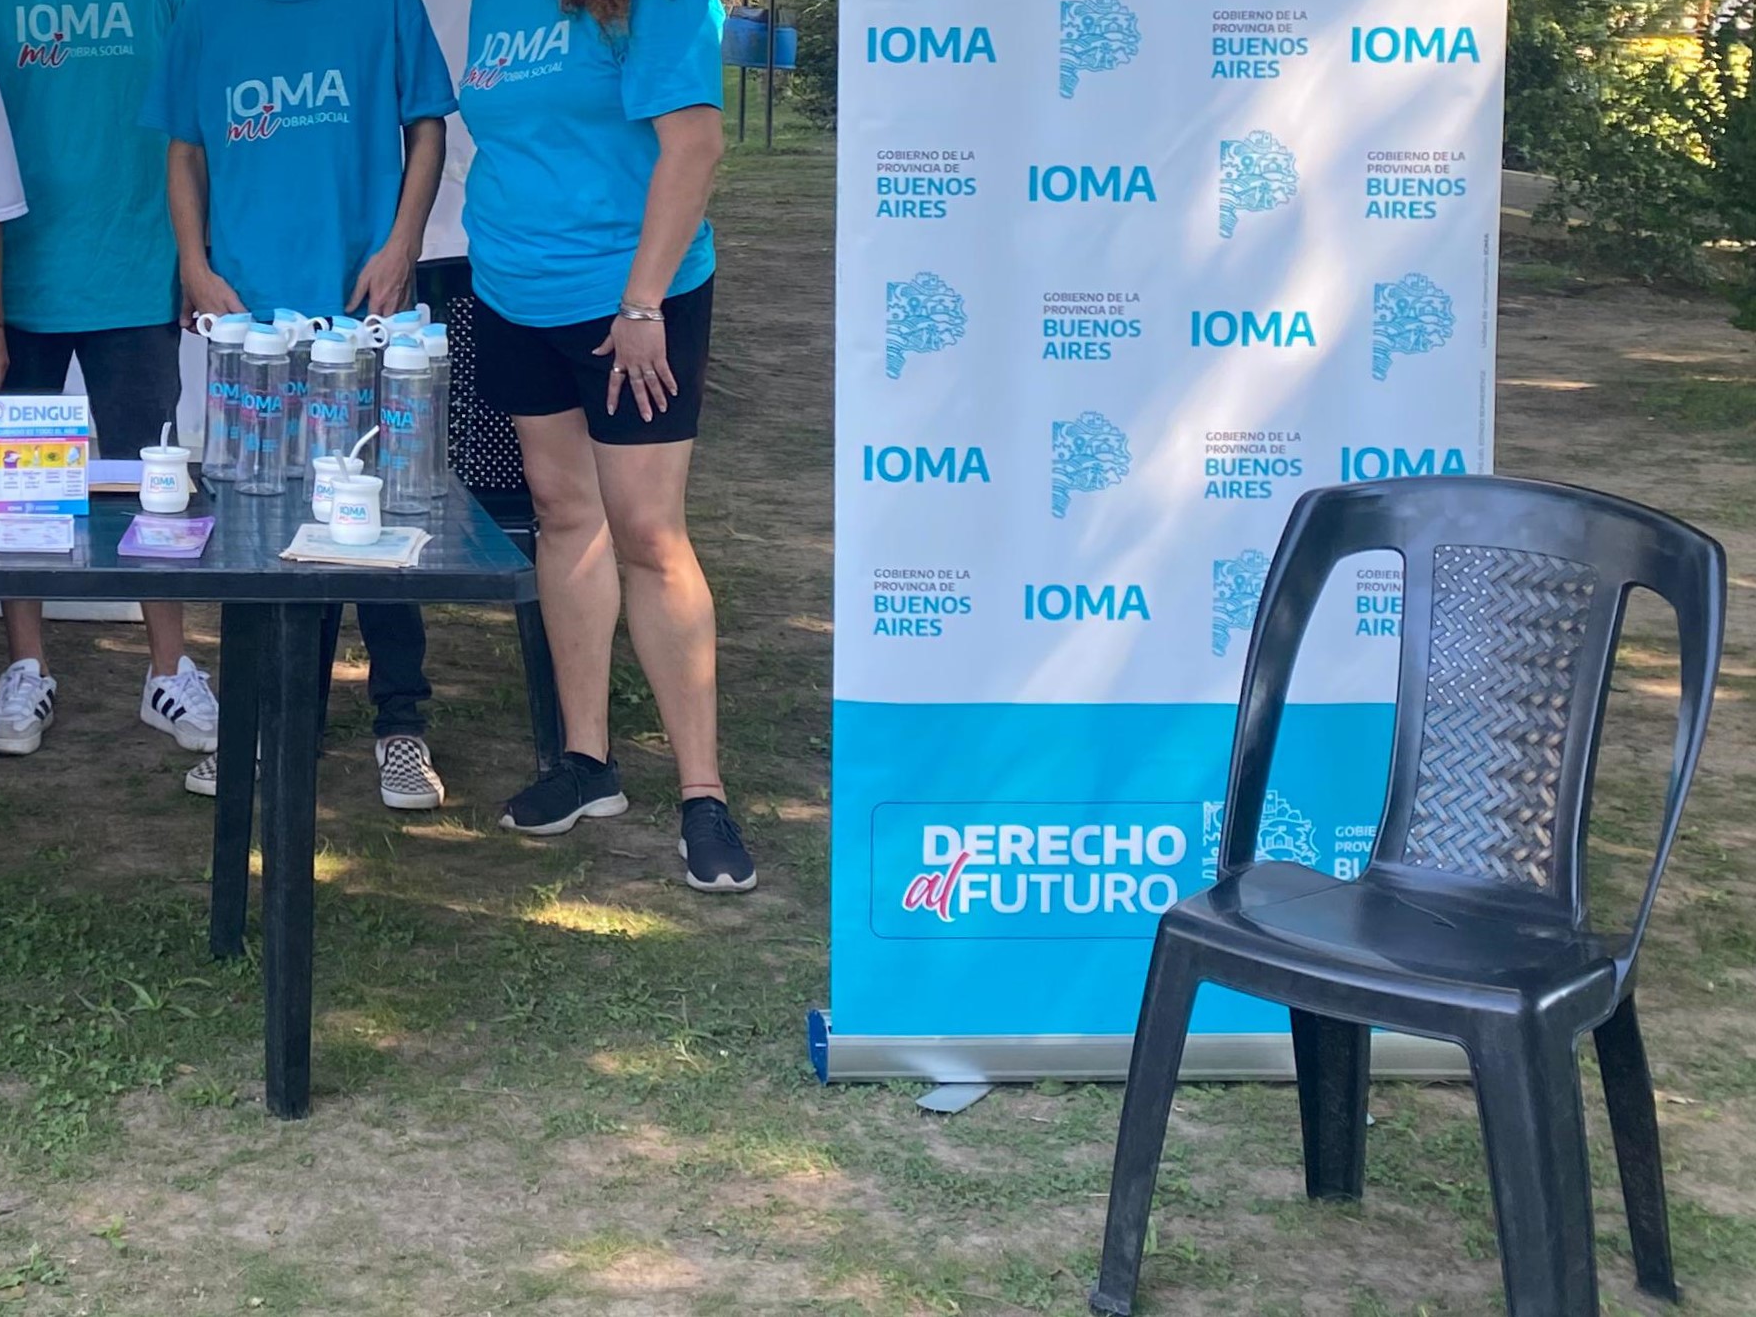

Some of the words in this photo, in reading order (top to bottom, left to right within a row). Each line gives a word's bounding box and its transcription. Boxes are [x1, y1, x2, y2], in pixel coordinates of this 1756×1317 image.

[15, 2, 134, 43] IOMA
[17, 32, 70, 69] mi
[867, 25, 996, 64] IOMA
[1350, 25, 1480, 64] IOMA
[226, 69, 350, 123] IOMA
[282, 115, 314, 127] OBRA
[1028, 165, 1157, 203] IOMA
[1191, 310, 1317, 347] IOMA
[9, 406, 83, 421] DENGUE
[862, 445, 990, 483] IOMA
[1341, 446, 1467, 483] IOMA
[1023, 583, 1150, 621] IOMA
[922, 824, 1187, 867] DERECHO
[903, 851, 972, 923] al
[958, 872, 1178, 915] FUTURO
